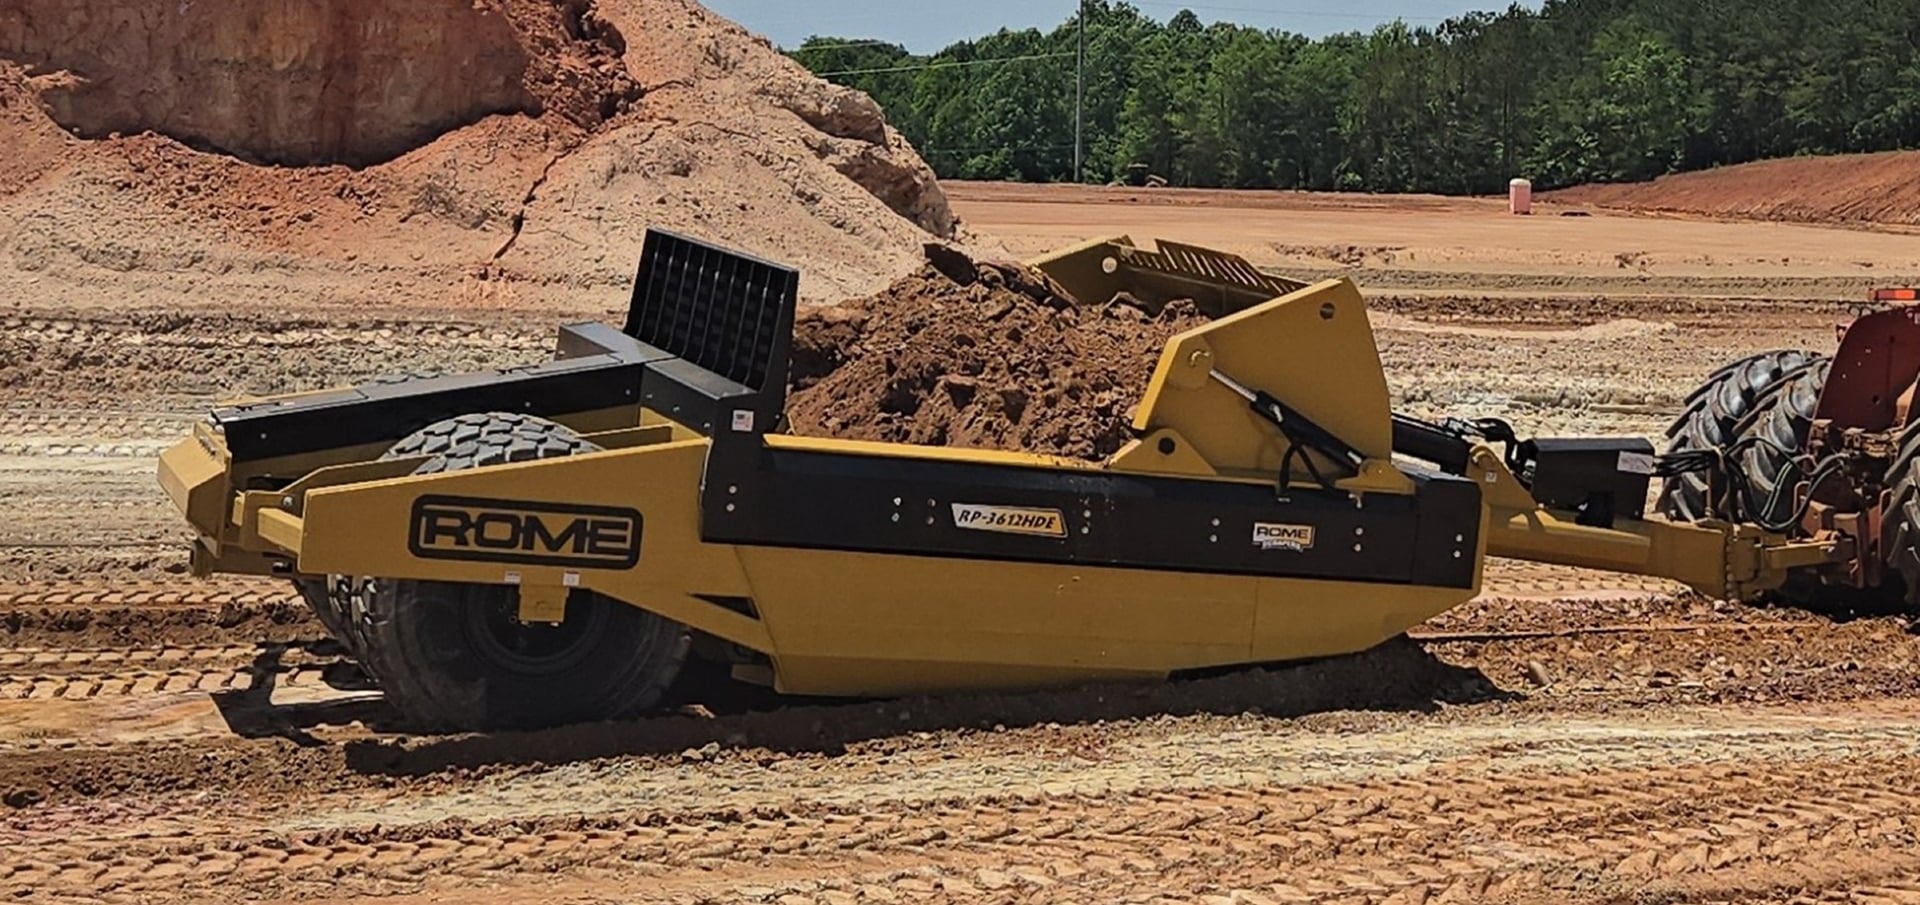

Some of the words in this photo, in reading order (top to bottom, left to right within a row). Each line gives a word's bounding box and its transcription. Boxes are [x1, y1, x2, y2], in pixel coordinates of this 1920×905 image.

[958, 509, 1057, 530] RP-3612HDE
[422, 509, 631, 555] ROME
[1256, 526, 1310, 540] ROME
